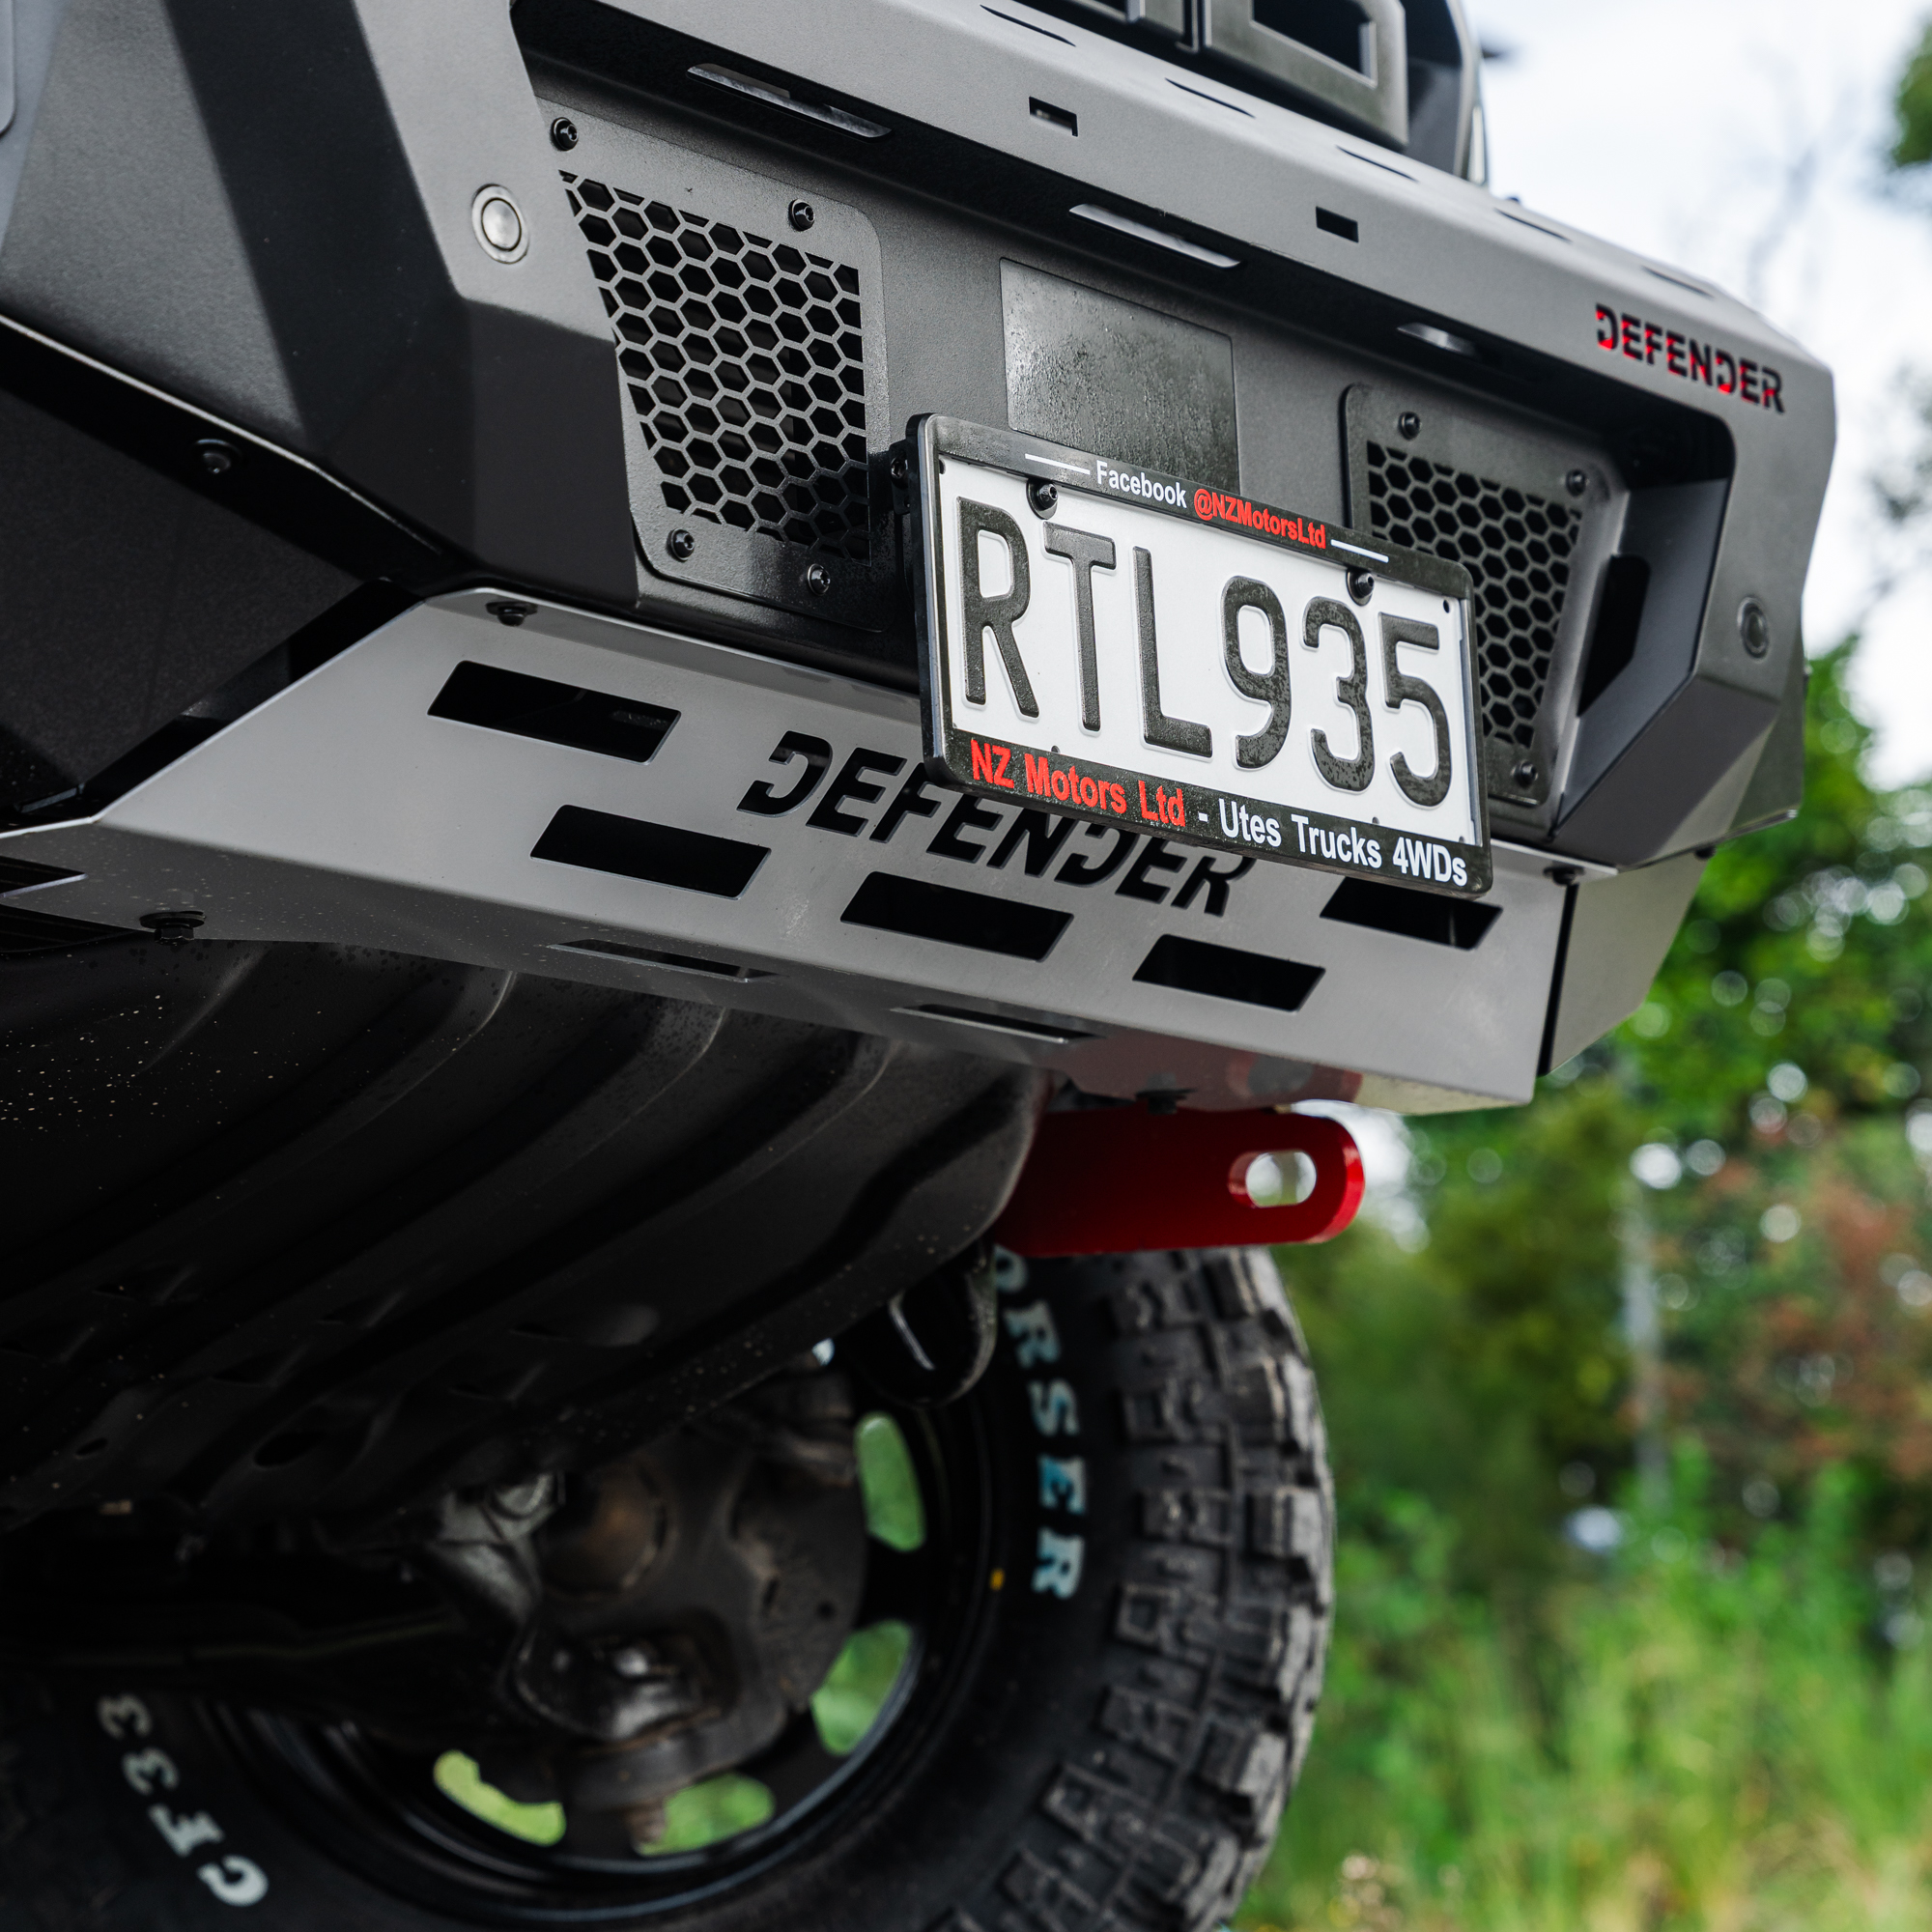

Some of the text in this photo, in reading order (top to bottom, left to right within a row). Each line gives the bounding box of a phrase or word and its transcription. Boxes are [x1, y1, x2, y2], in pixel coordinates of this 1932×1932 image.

[1596, 302, 1785, 414] DEFENDER
[1096, 460, 1326, 549] Facebook @NZMotorsLtd
[956, 497, 1452, 808] RTL935
[970, 738, 1014, 789] NZ
[1024, 753, 1127, 814] Motors
[1138, 780, 1186, 828] Ltd
[1218, 797, 1282, 847] Utes
[1291, 813, 1382, 868] Trucks
[1392, 837, 1468, 887] 4WDs
